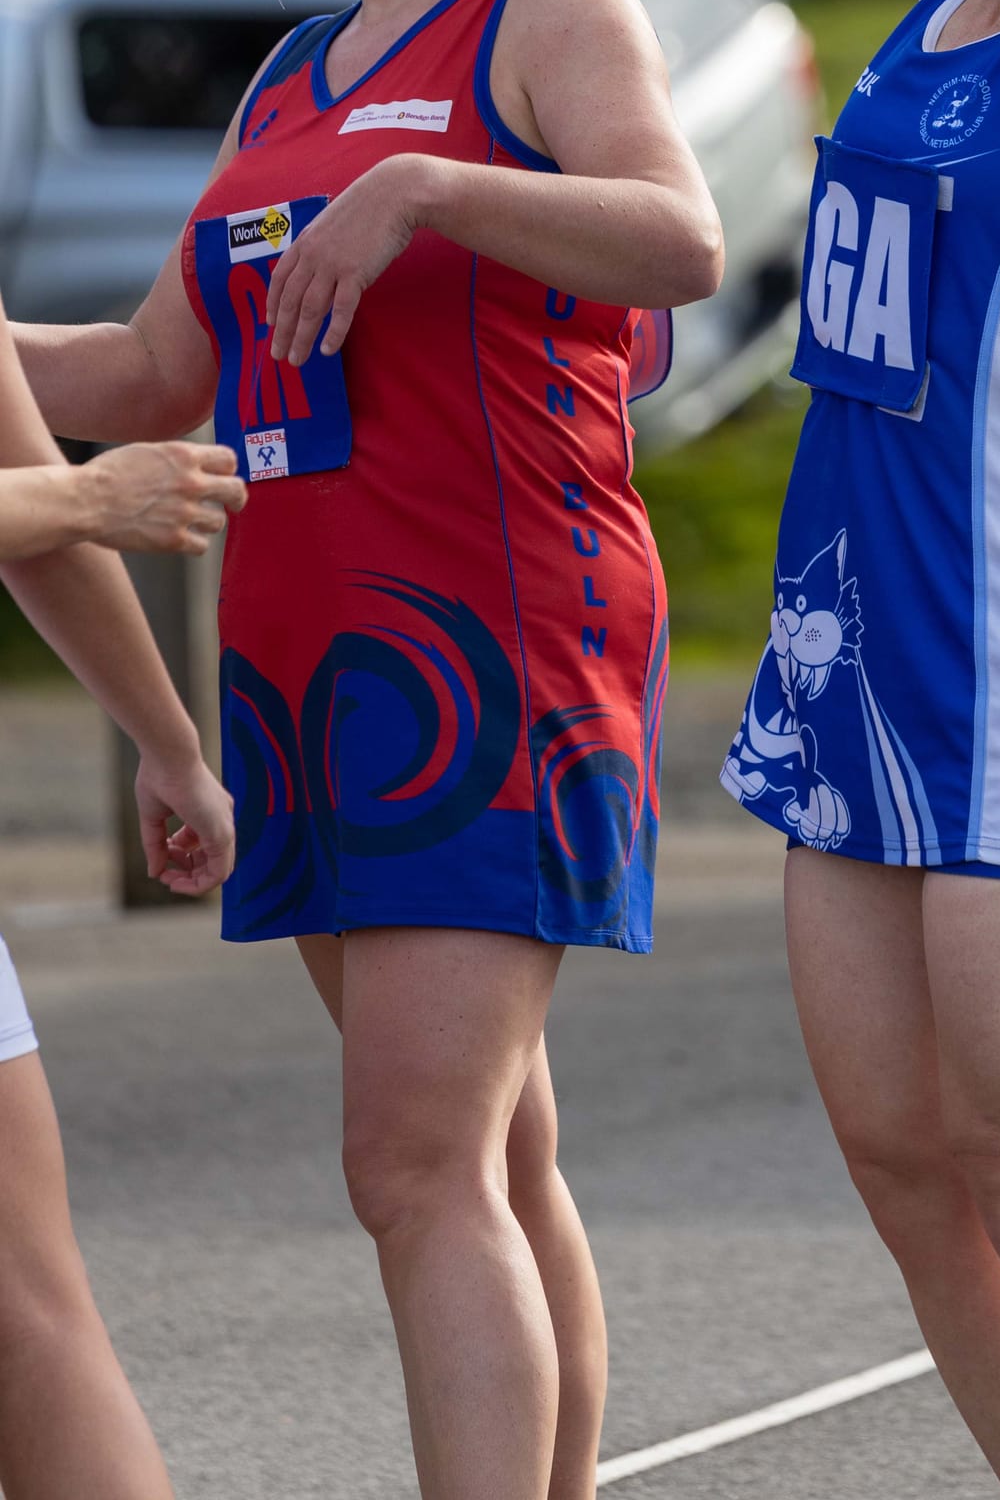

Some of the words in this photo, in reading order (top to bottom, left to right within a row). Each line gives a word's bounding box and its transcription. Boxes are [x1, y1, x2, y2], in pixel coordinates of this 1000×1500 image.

[919, 108, 931, 145] FOOTBALL
[929, 135, 966, 149] NETBALL
[964, 115, 985, 138] CLUB
[928, 73, 983, 106] NEERIM-NEE
[978, 79, 992, 113] SOUTH
[807, 180, 915, 372] GA
[543, 287, 576, 417] ULN
[560, 481, 607, 658] BULN
